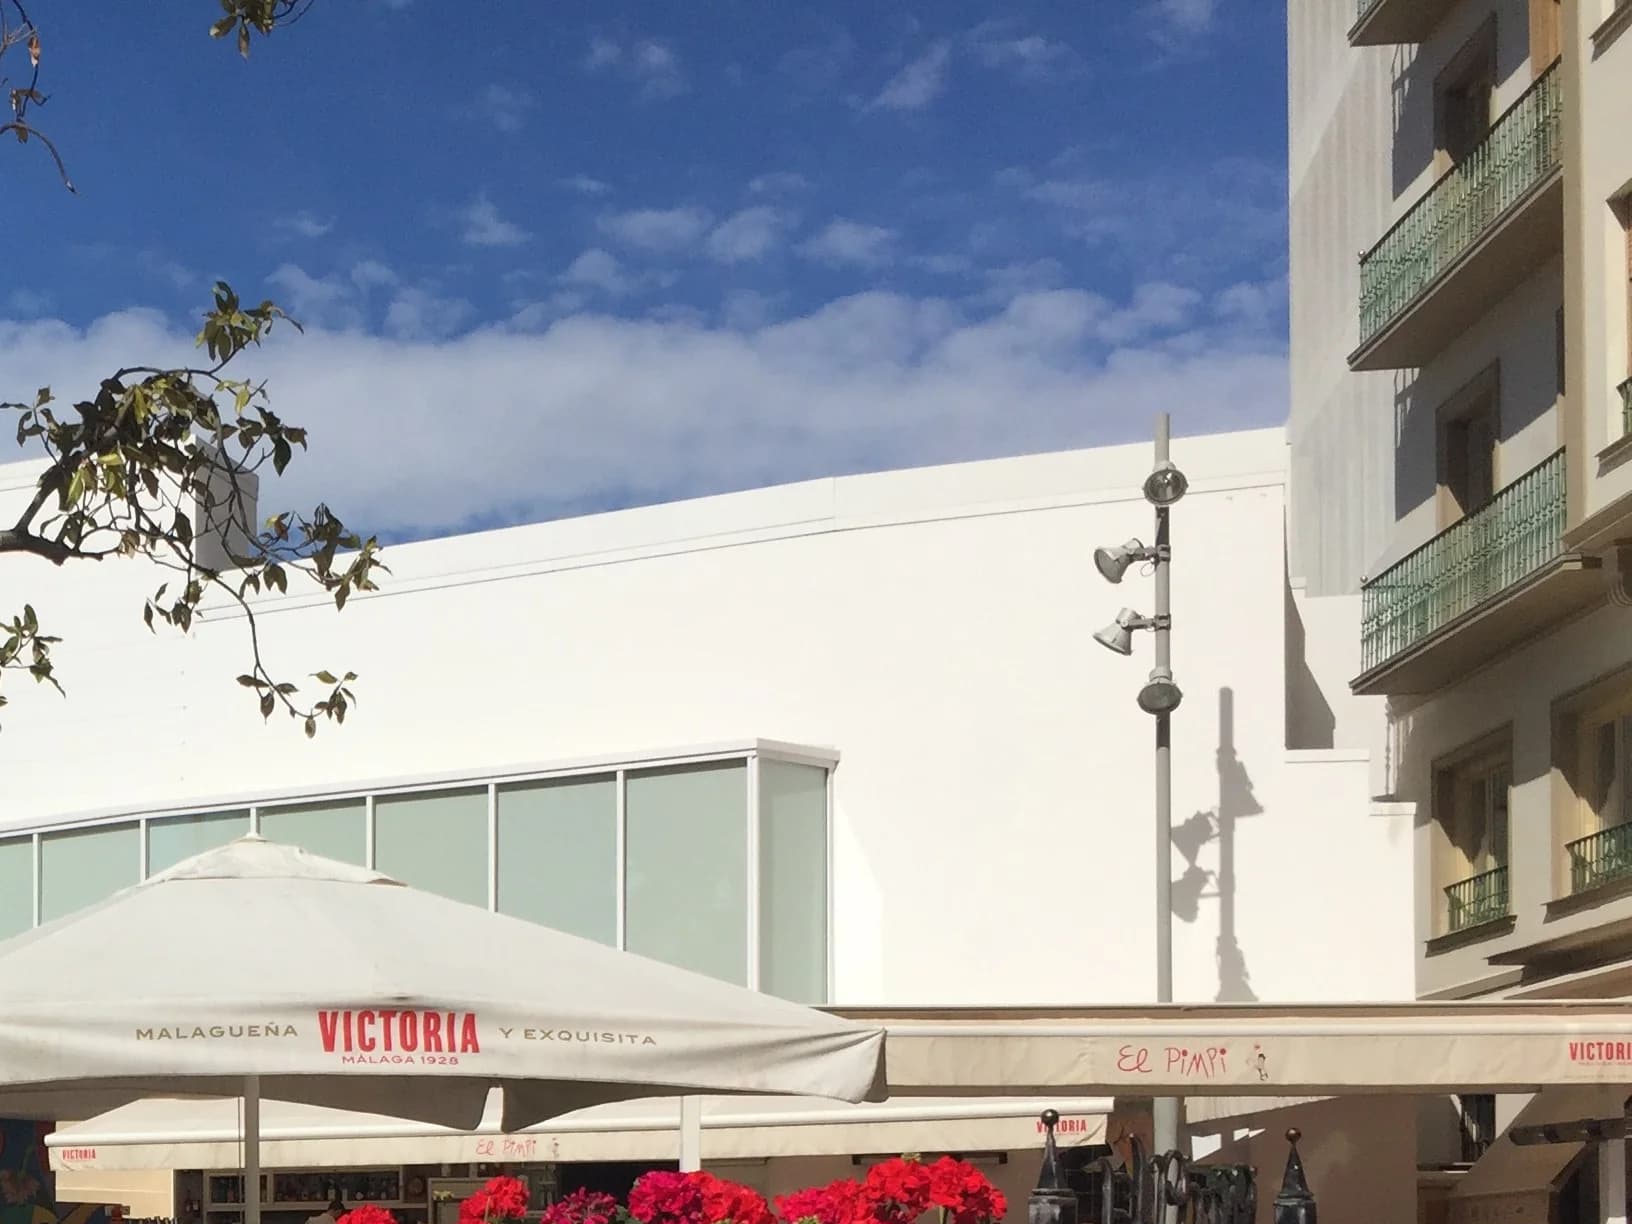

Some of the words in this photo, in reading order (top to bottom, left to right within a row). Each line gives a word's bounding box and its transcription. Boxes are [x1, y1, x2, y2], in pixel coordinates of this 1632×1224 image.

[135, 1022, 299, 1041] MALAGUEÑA
[317, 1009, 481, 1054] VICTORIA
[498, 1027, 515, 1039] Y
[523, 1028, 657, 1047] EXQUISITA
[1117, 1044, 1153, 1073] El
[1569, 1042, 1632, 1061] VICTORI
[420, 1055, 460, 1067] 1928
[1036, 1119, 1088, 1133] VITORIA
[62, 1148, 97, 1160] VICTORIA
[476, 1138, 496, 1156] El
